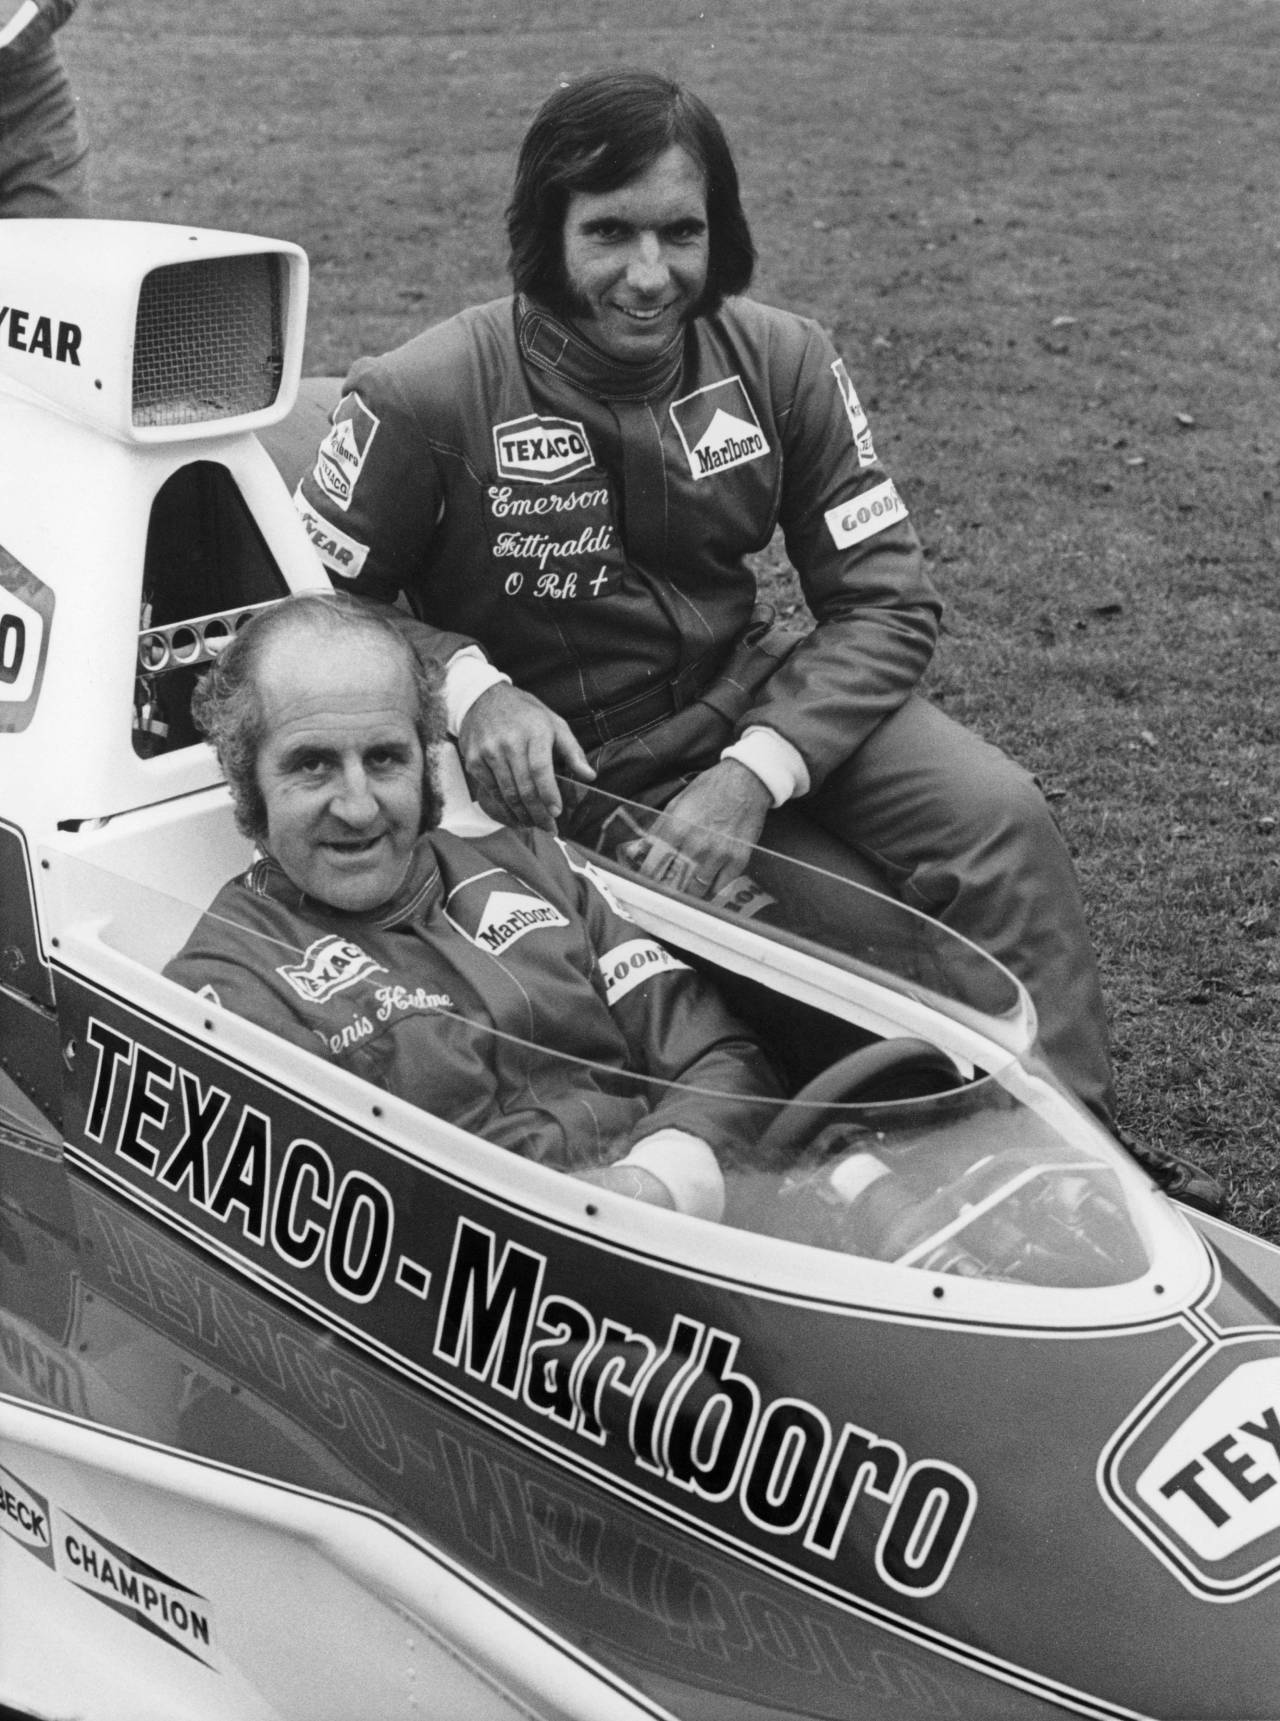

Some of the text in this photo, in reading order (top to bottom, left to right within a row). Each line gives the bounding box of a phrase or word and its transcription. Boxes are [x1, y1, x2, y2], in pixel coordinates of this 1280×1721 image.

[502, 434, 585, 463] TEXACO
[695, 433, 763, 473] Marlboro
[488, 486, 609, 517] Emerson
[492, 525, 614, 570] Fittipaldi
[533, 572, 577, 599] Rh
[313, 1013, 374, 1054] enis
[65, 1535, 210, 1646] CHAMPION
